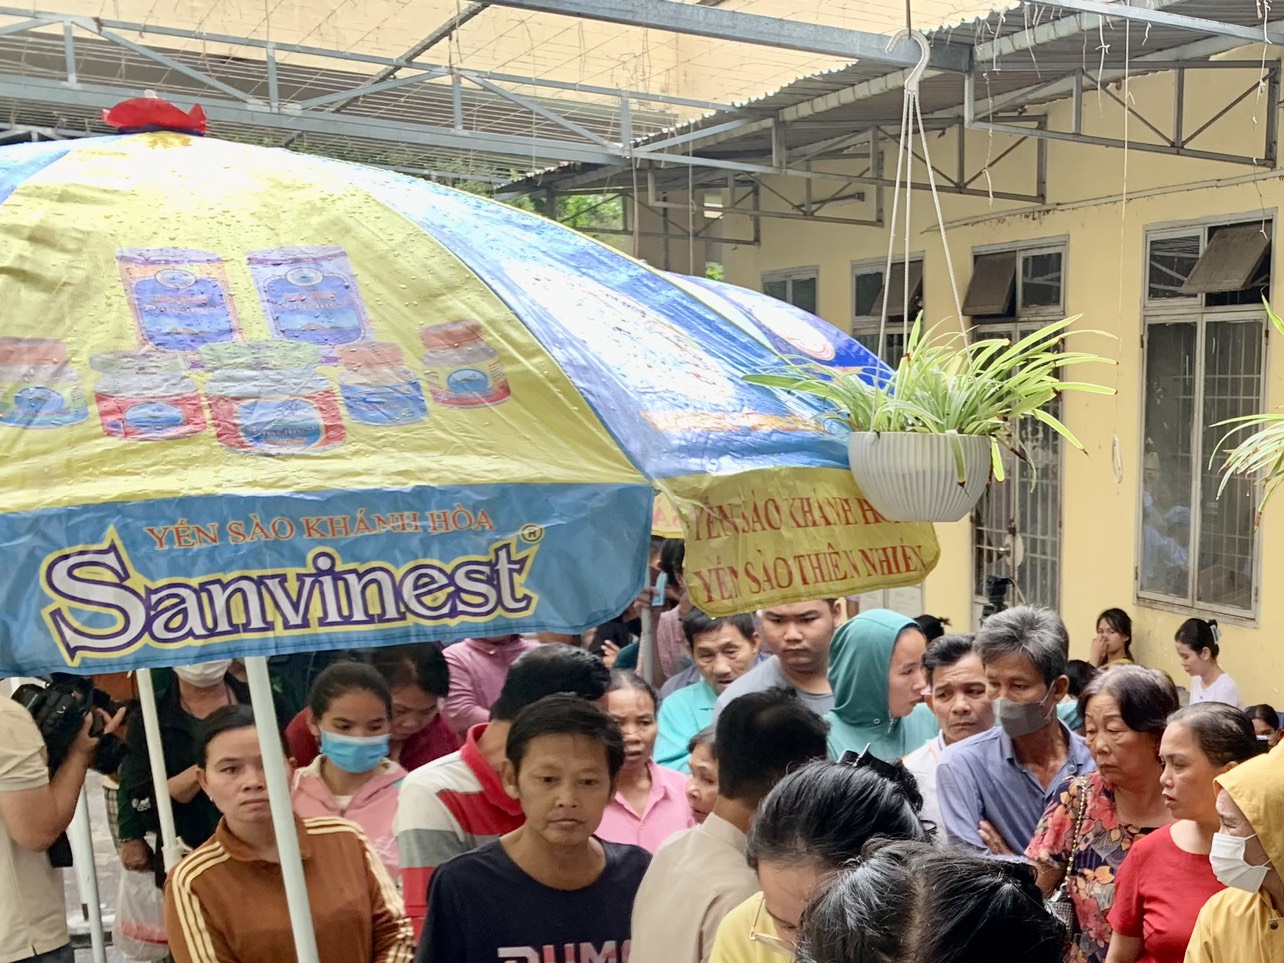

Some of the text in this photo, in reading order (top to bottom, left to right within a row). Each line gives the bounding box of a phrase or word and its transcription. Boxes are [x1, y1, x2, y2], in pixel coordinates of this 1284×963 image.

[146, 503, 496, 551] YẾN SÀO KHÁNH HÒA
[46, 538, 536, 664] Sanvinest
